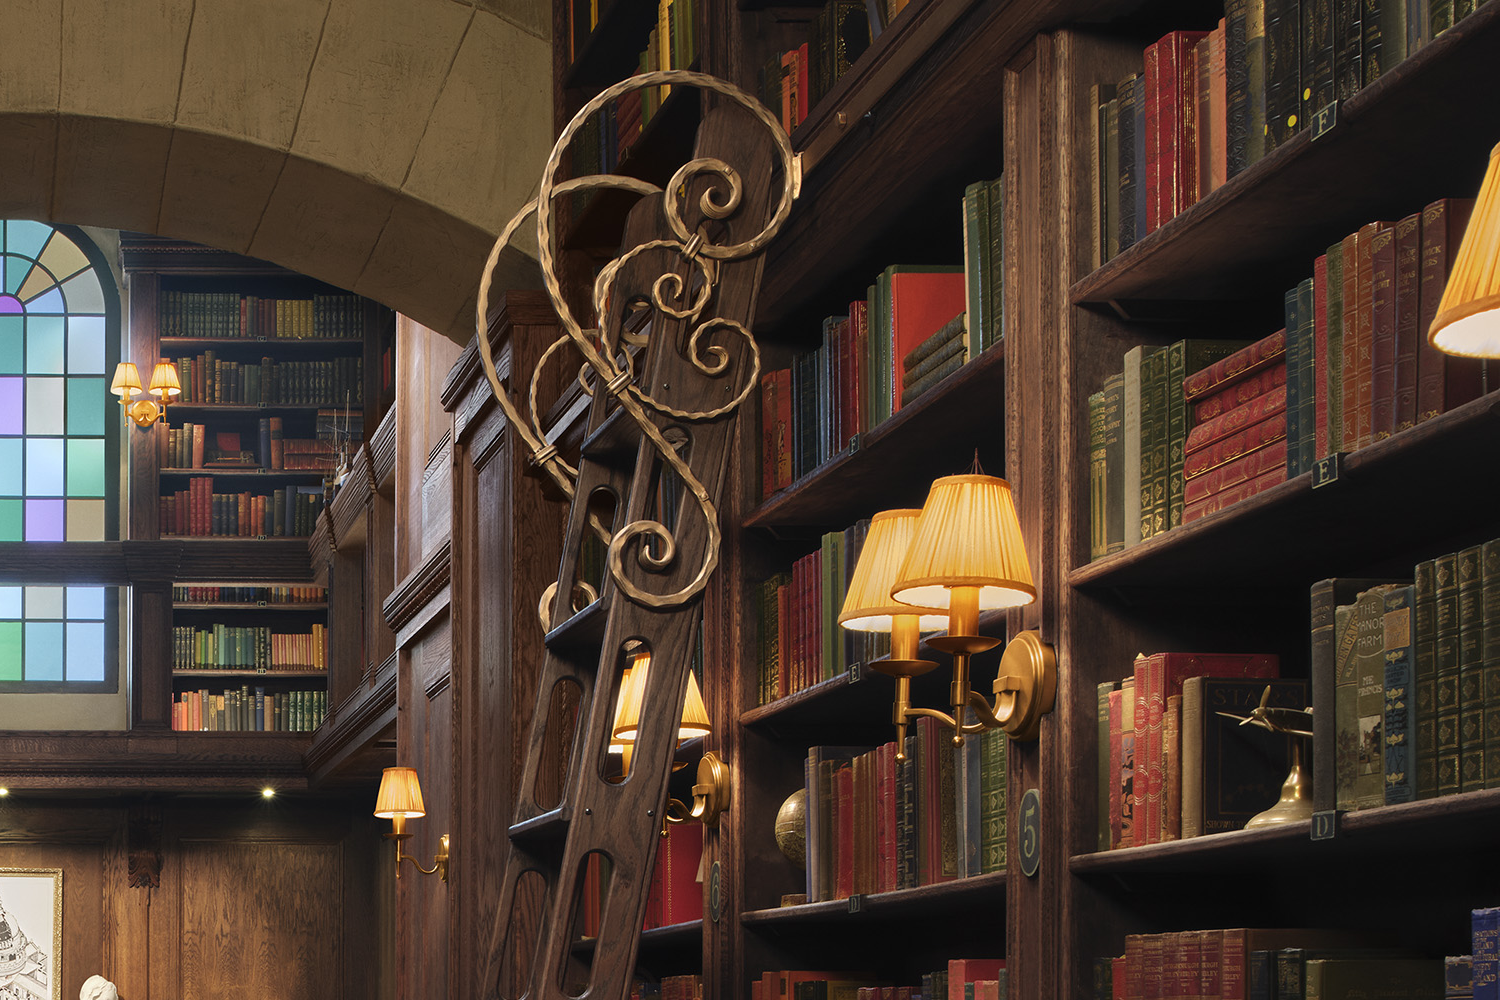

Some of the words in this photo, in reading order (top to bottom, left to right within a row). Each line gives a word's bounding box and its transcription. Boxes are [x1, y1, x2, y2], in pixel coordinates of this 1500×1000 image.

[1315, 109, 1329, 135] F
[849, 437, 857, 453] F
[1317, 460, 1330, 484] E
[1359, 601, 1377, 616] THE
[1357, 616, 1385, 633] MANOR
[1357, 633, 1383, 649] FARM
[850, 665, 857, 681] E
[1212, 687, 1299, 707] STARS
[1022, 804, 1035, 858] 5
[1316, 816, 1328, 837] D
[711, 871, 720, 910] 6
